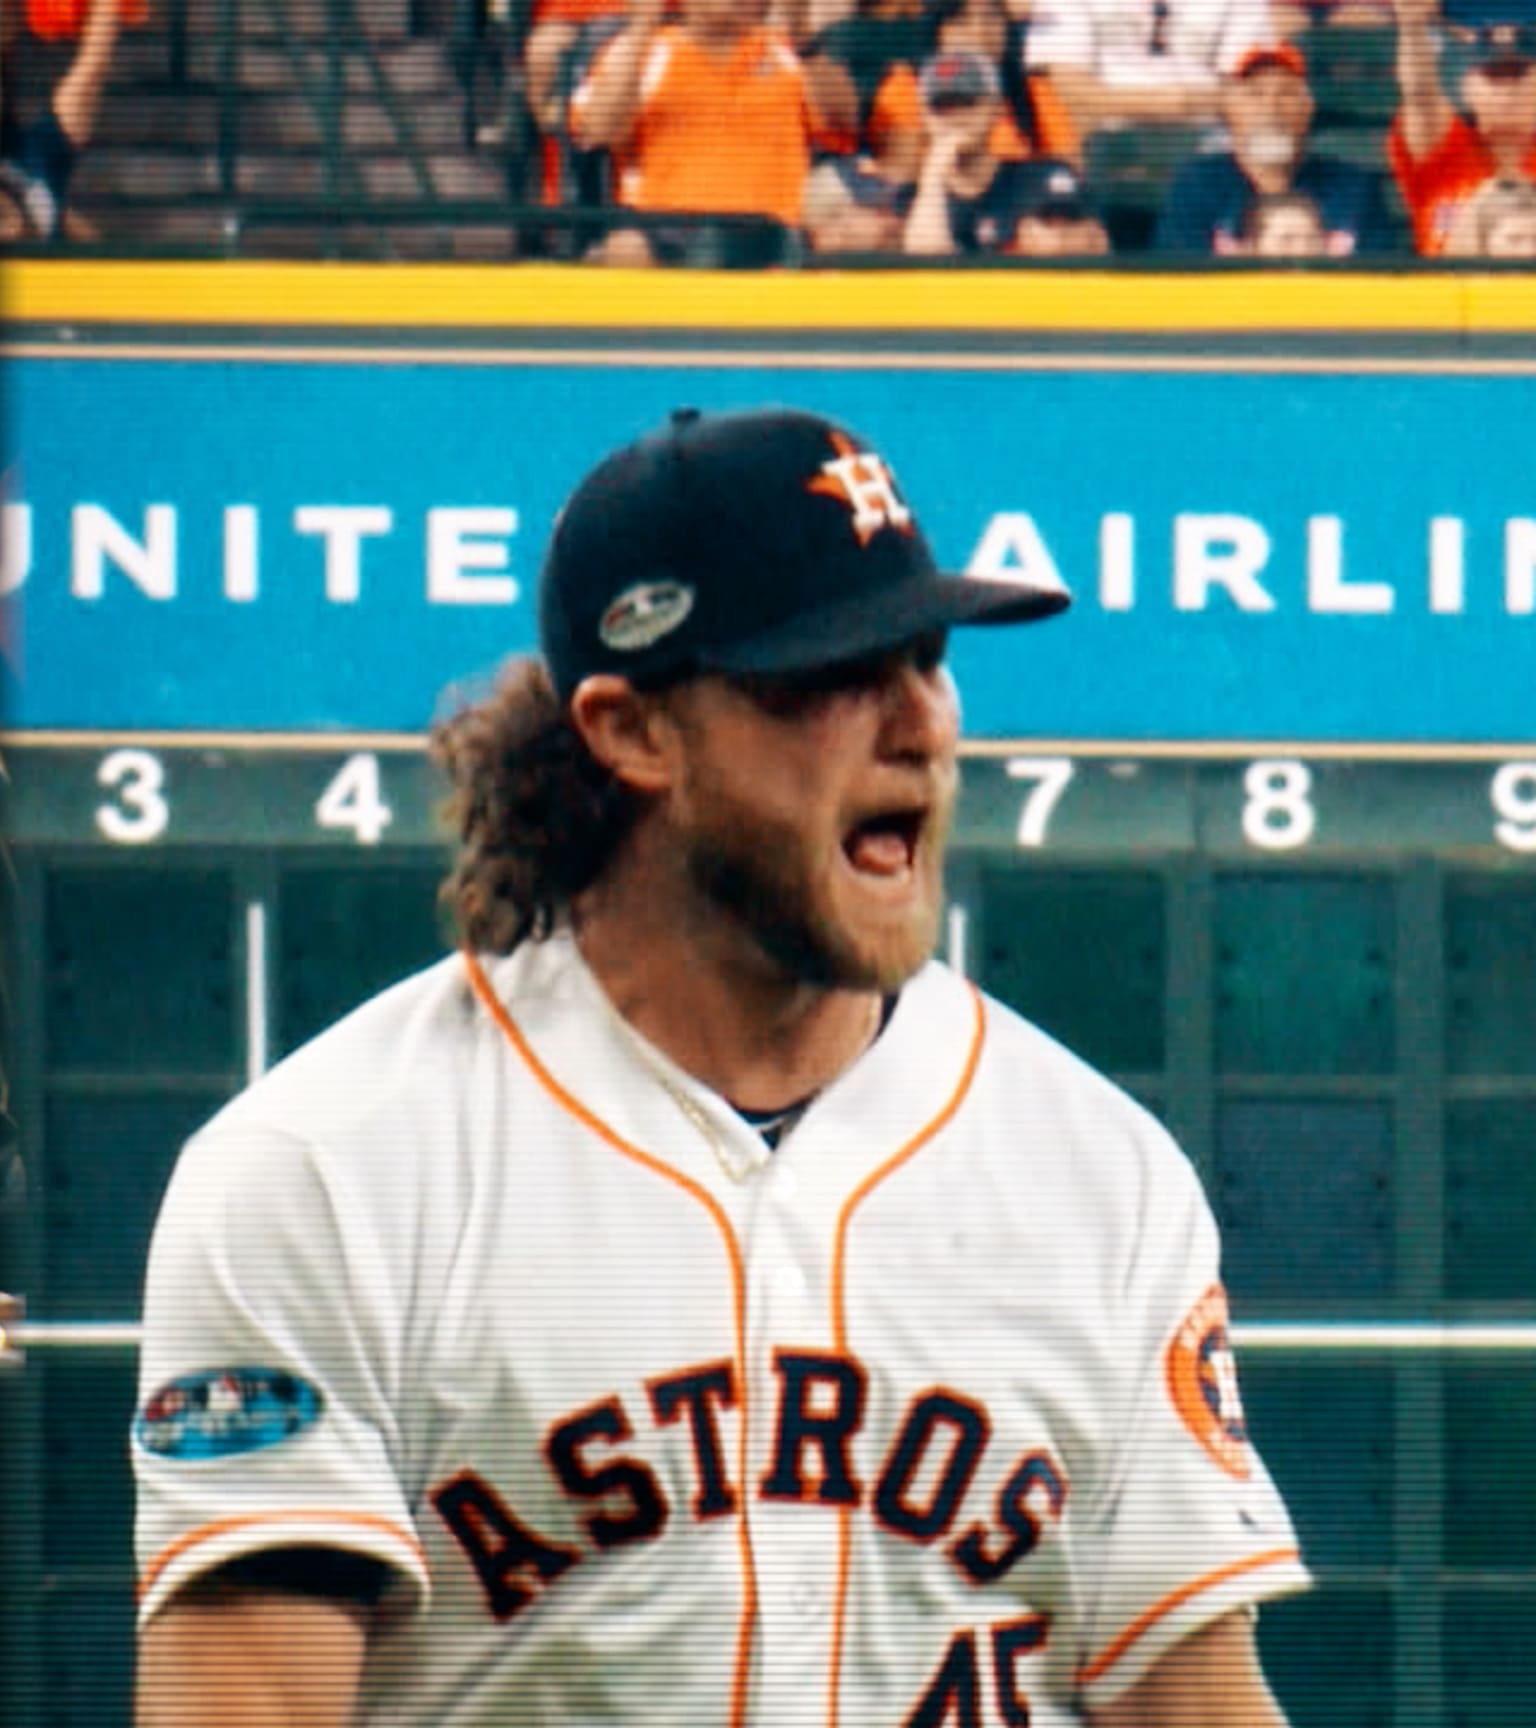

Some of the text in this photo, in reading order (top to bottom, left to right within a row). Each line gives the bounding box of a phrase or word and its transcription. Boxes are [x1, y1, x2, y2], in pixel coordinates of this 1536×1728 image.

[820, 452, 911, 528] H
[96, 750, 1536, 850] 3 4 7 8 9
[426, 1345, 1070, 1625] ASTROS
[898, 1612, 1054, 1728] 45
